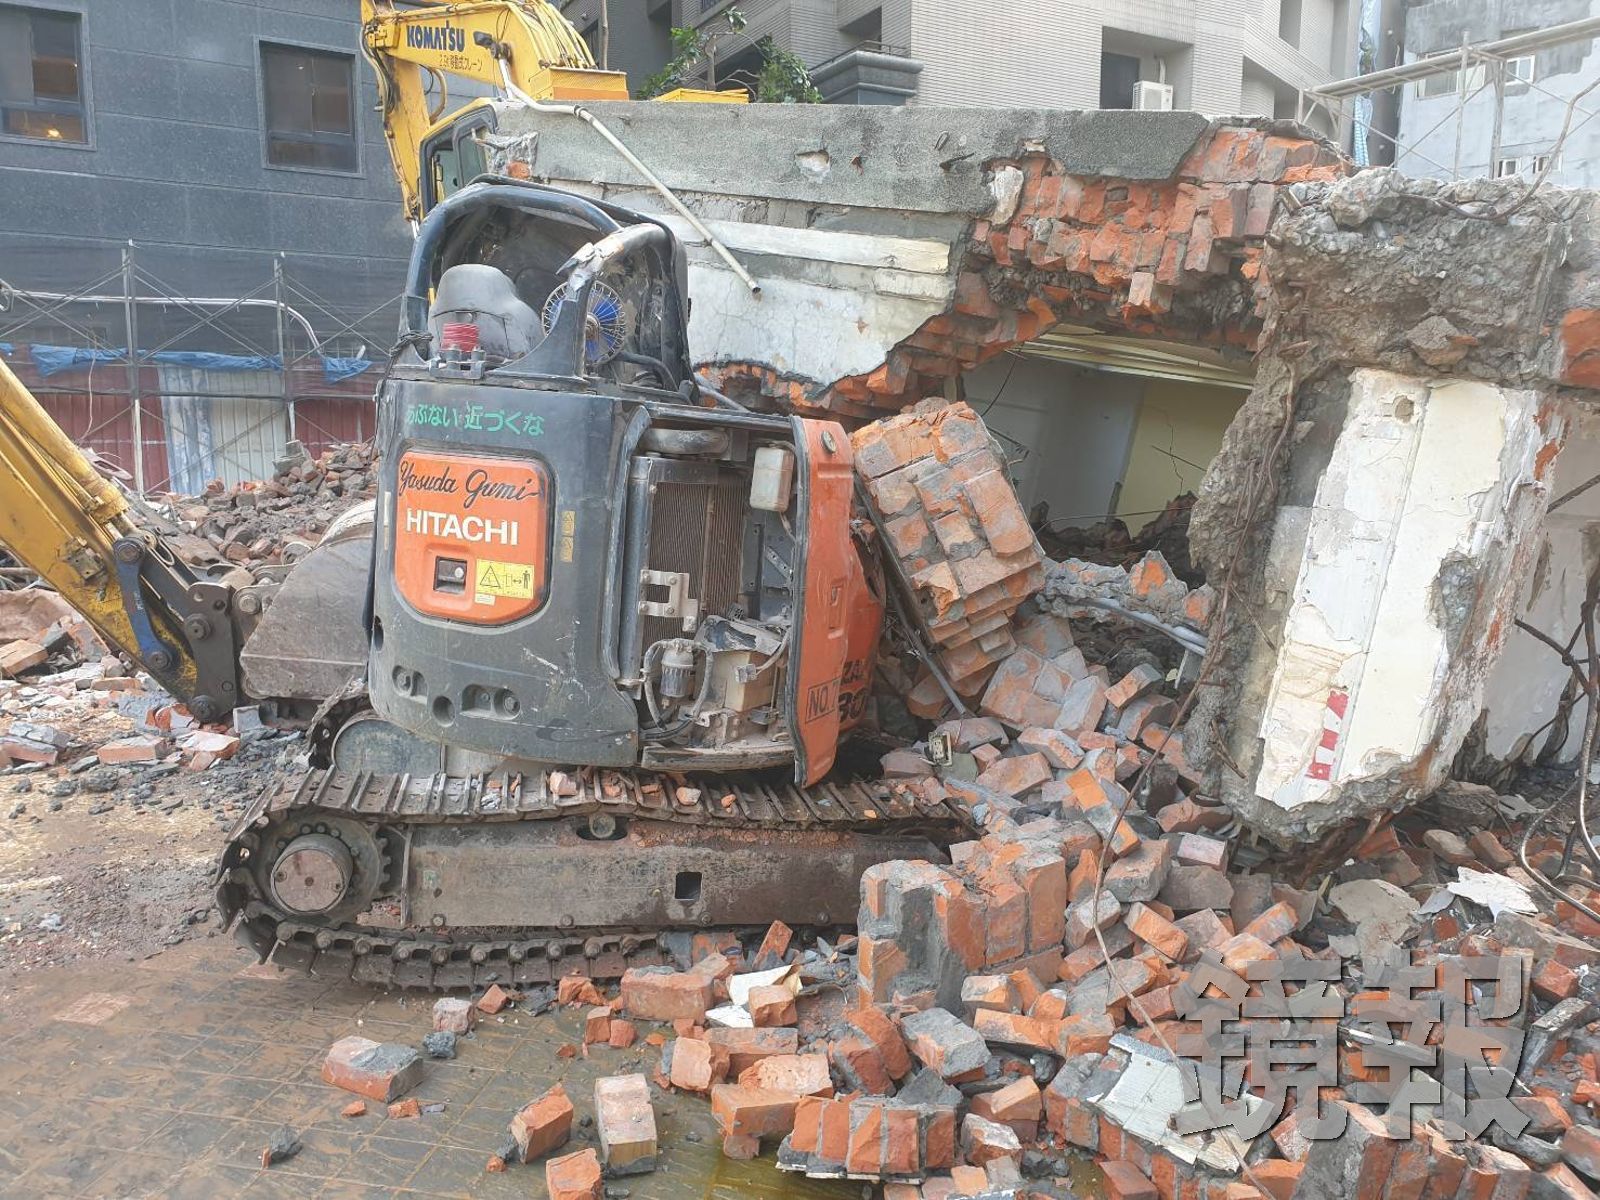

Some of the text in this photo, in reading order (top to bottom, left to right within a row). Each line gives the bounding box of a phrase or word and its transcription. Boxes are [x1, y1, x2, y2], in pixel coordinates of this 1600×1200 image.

[406, 20, 465, 52] KOMATSU
[399, 461, 540, 509] Yasuda Gumi
[406, 507, 519, 545] HITACHI
